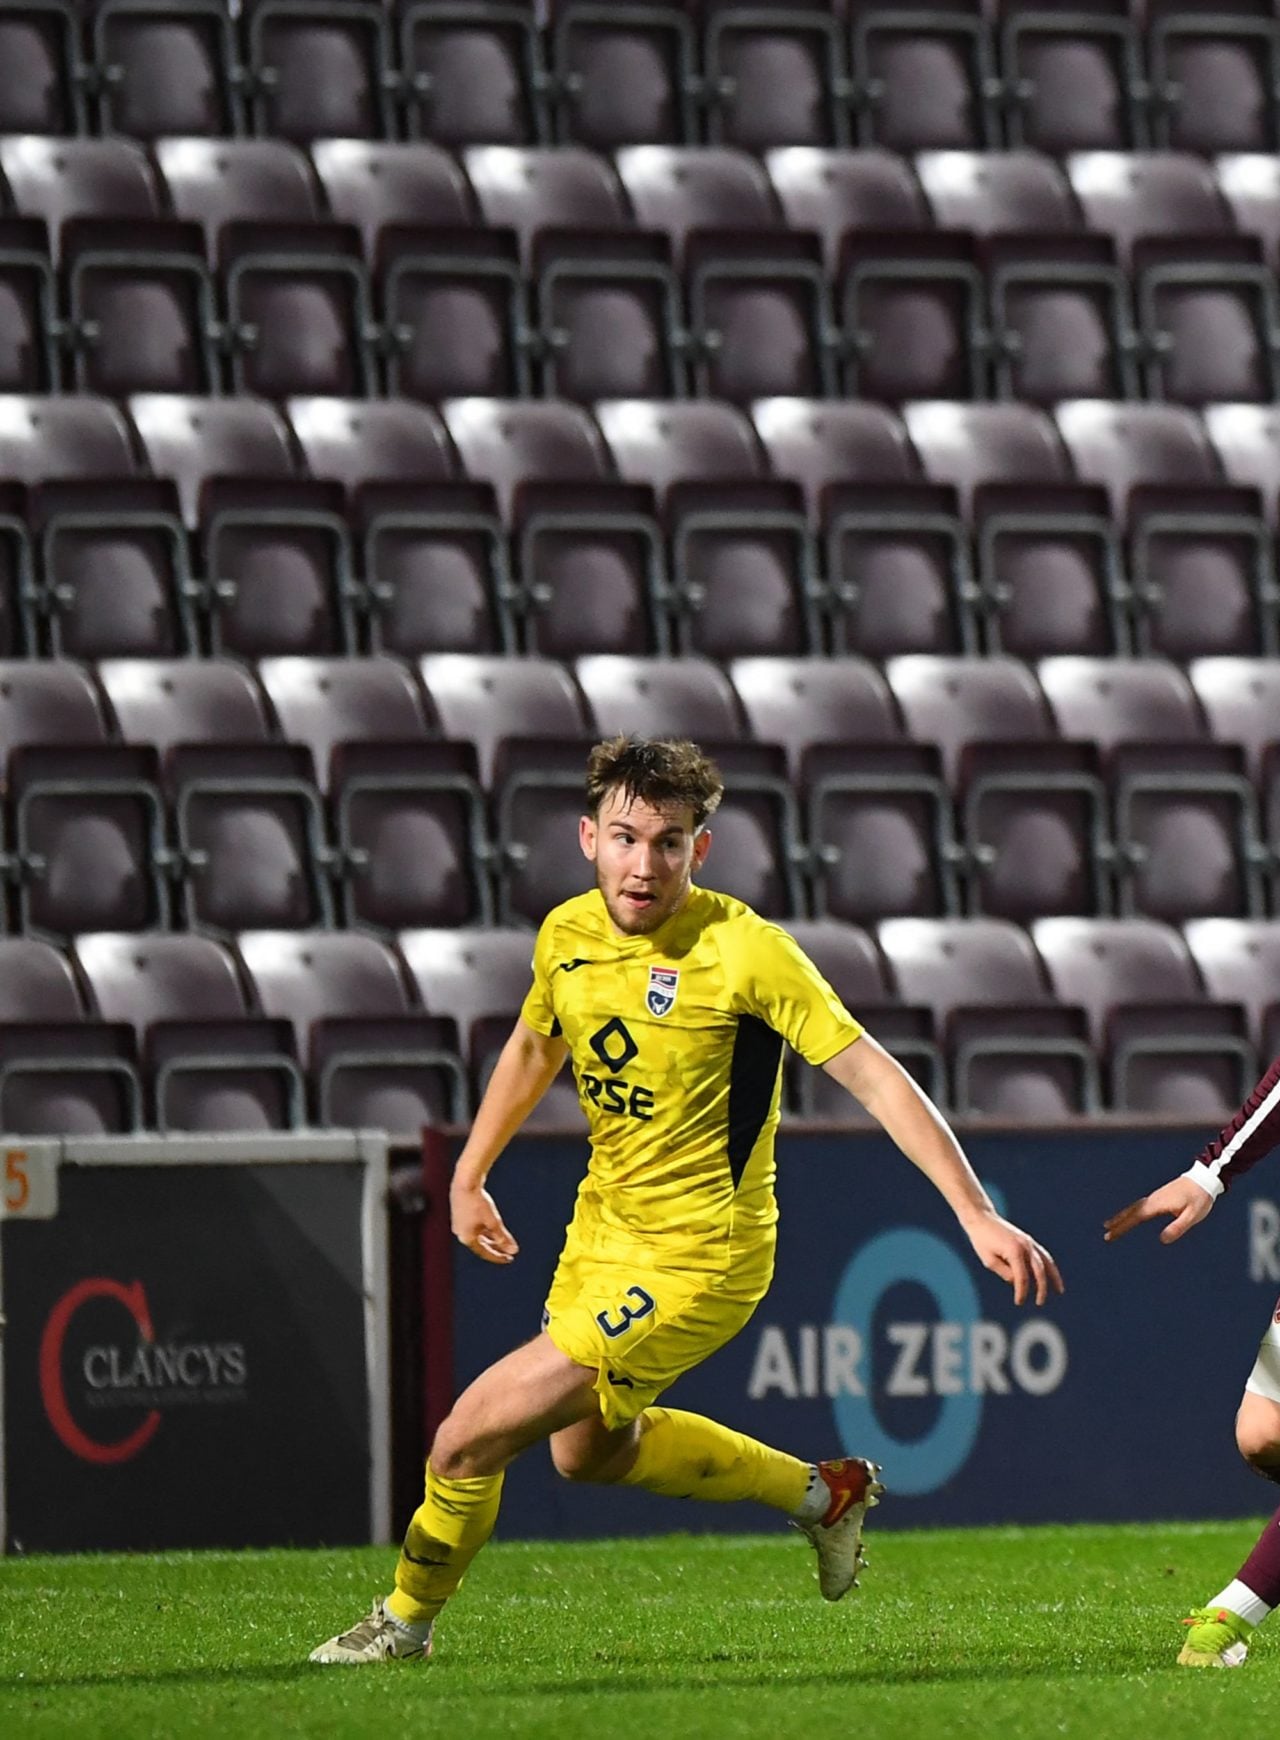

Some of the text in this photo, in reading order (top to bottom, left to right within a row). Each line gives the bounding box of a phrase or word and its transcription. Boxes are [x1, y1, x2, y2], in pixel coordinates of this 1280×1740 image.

[581, 1074, 654, 1120] RSE
[5, 1150, 29, 1212] 5
[596, 1286, 656, 1338] 3
[83, 1343, 247, 1389] CLANCYS
[749, 1320, 1067, 1399] AIR ZERO
